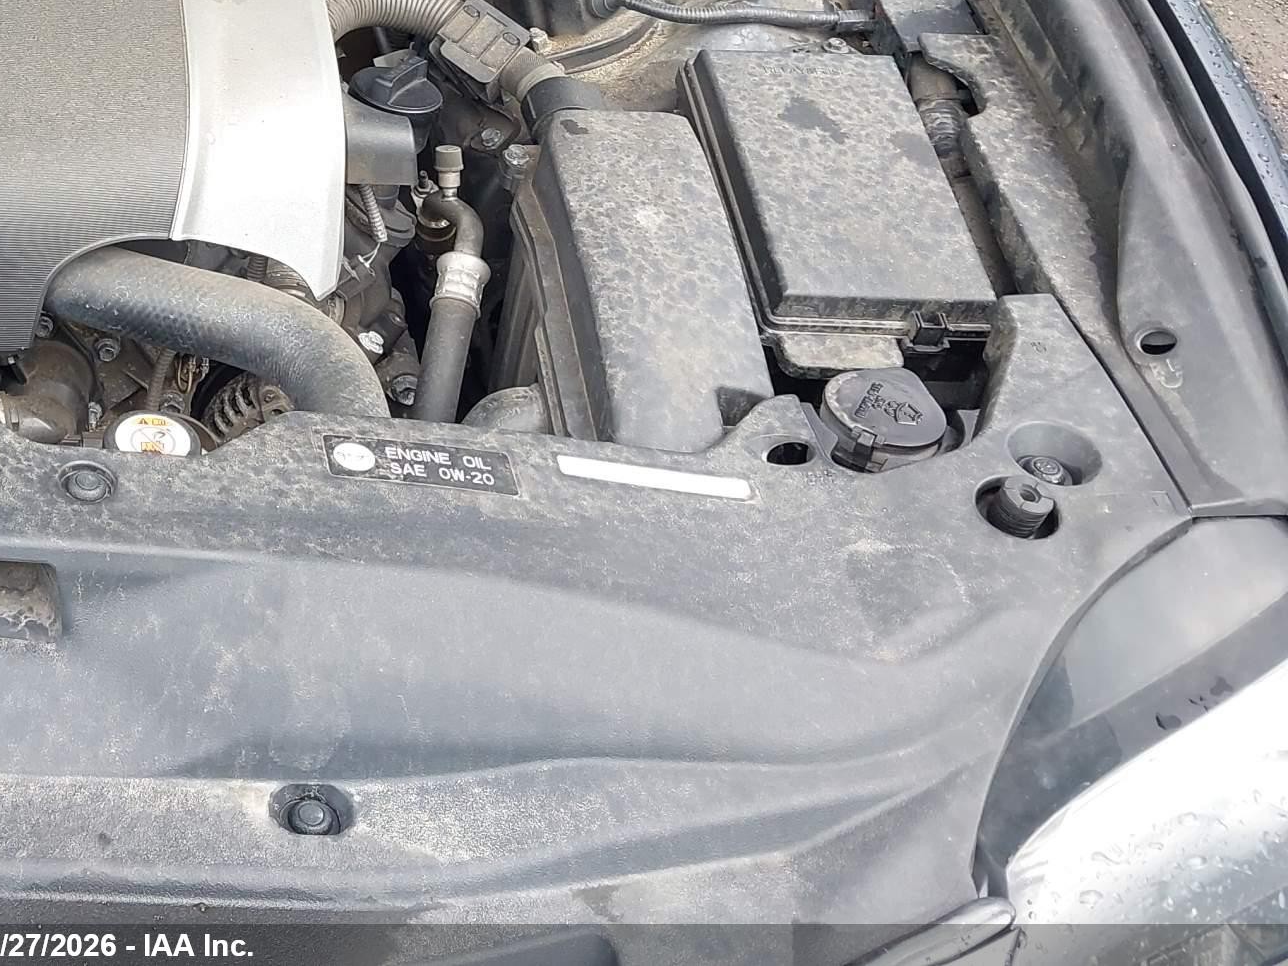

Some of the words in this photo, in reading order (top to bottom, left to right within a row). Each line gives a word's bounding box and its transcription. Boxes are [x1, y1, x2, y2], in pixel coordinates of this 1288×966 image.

[385, 446, 452, 465] ENGINE
[463, 455, 492, 471] OIL
[390, 464, 427, 477] SAE
[439, 466, 494, 485] 0W-20
